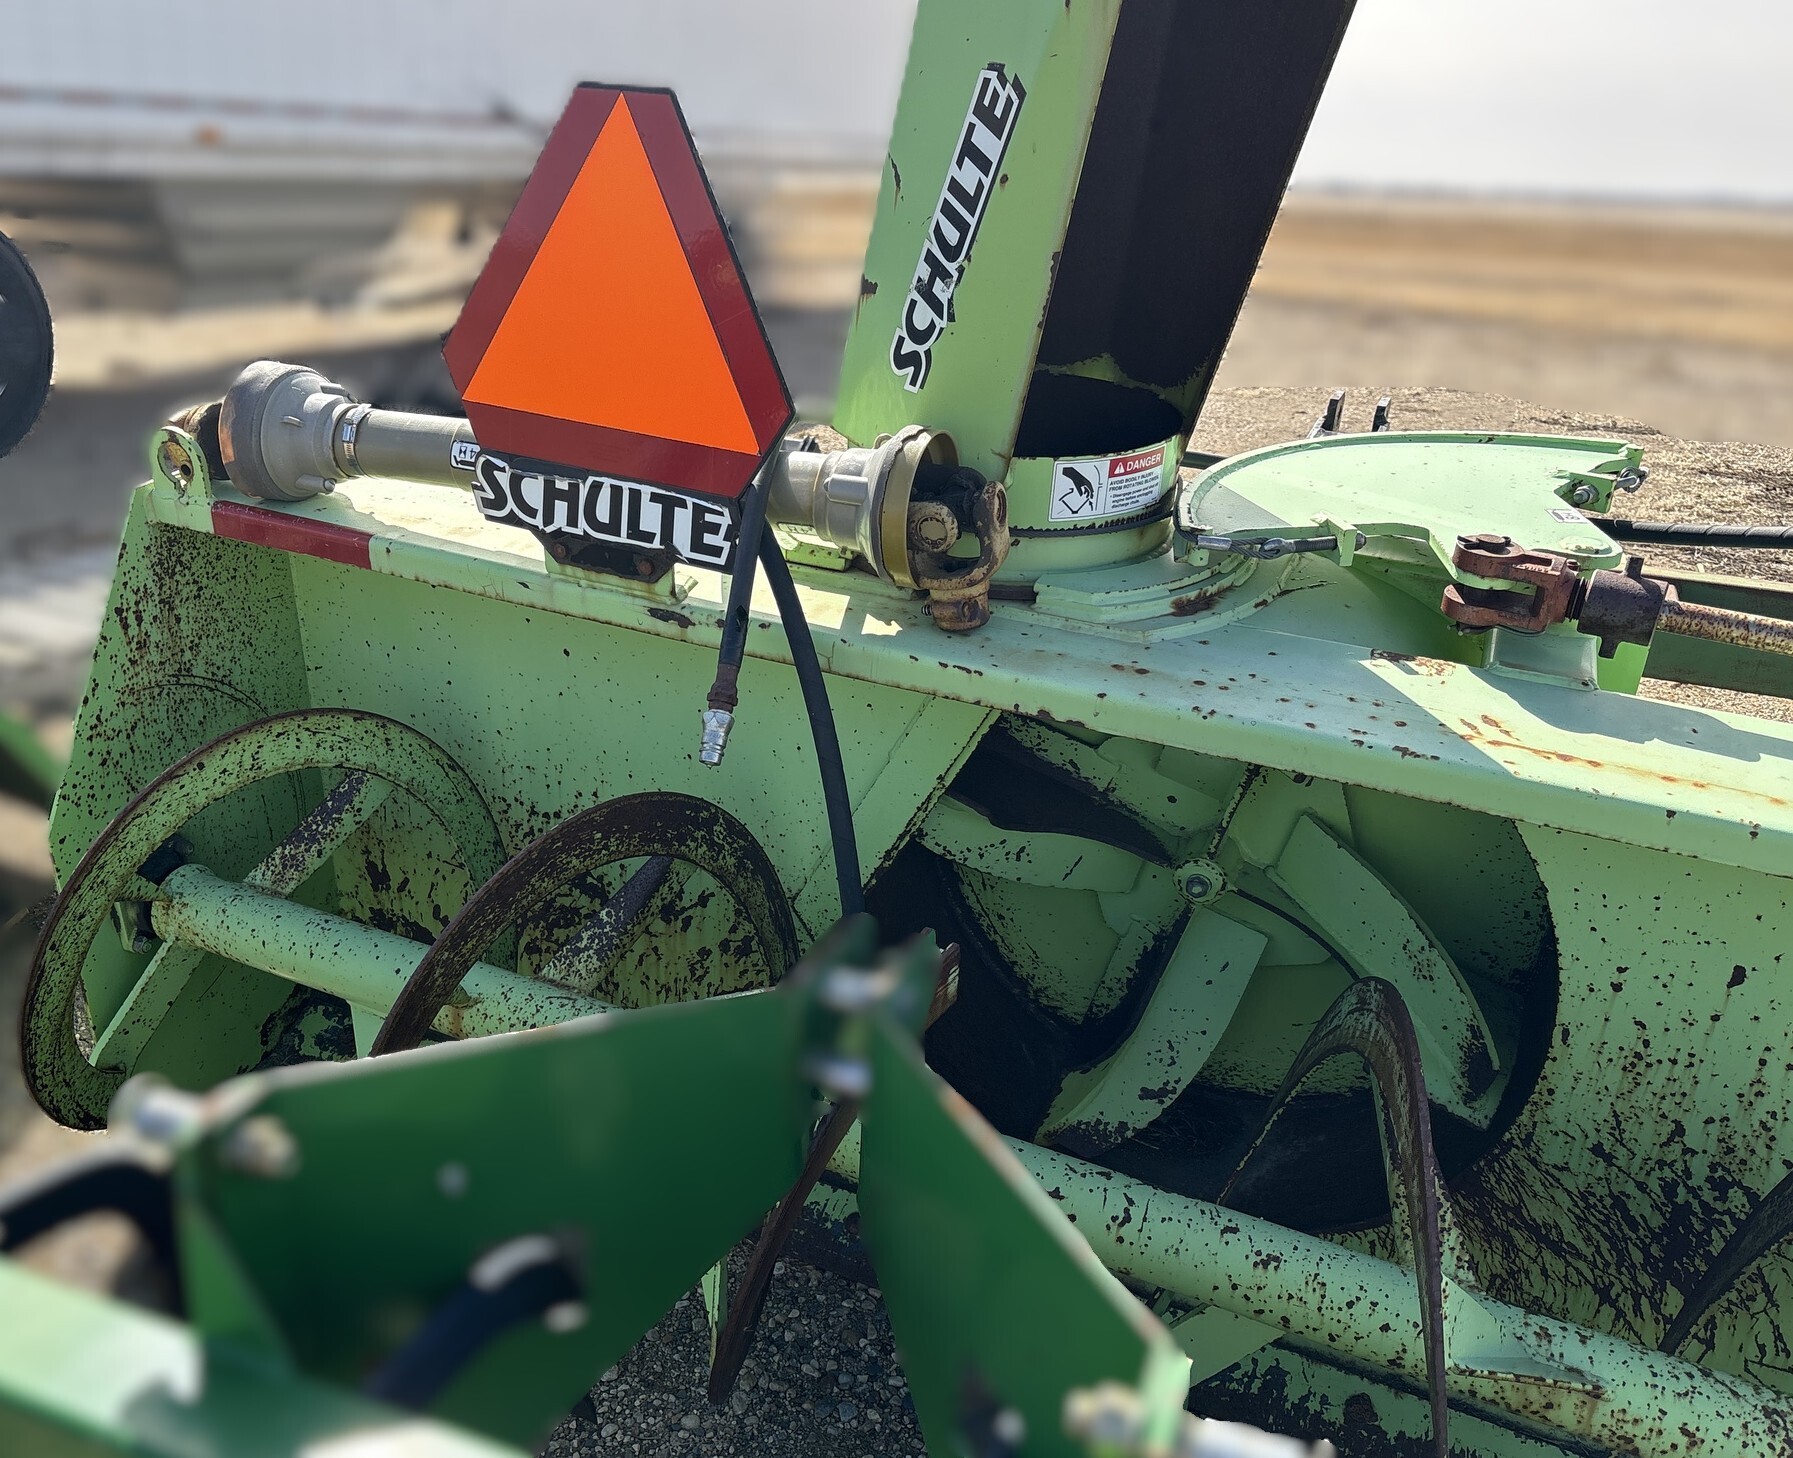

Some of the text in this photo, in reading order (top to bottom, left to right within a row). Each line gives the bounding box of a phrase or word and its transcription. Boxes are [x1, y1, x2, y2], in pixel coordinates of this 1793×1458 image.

[890, 68, 1020, 392] SCHULTE
[1123, 480, 1144, 489] ROTATING
[1126, 453, 1161, 472] DANGER
[475, 455, 731, 564] SCHULTE
